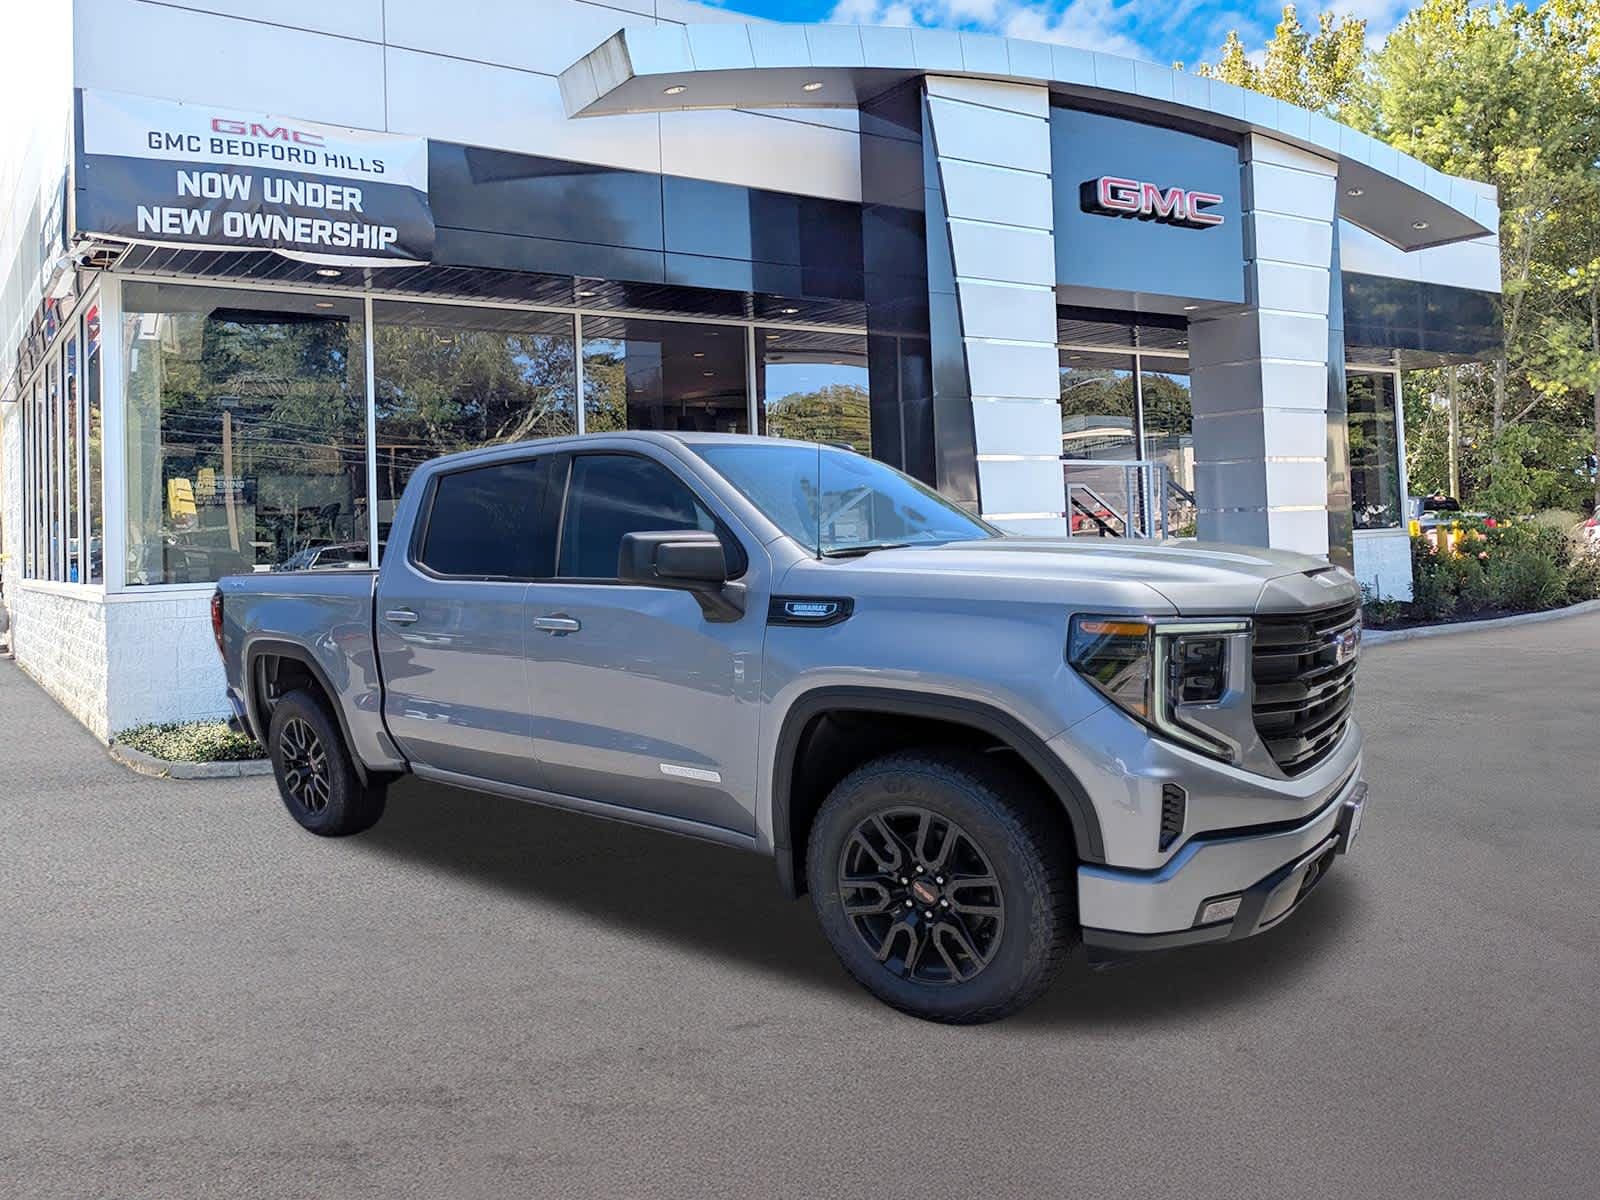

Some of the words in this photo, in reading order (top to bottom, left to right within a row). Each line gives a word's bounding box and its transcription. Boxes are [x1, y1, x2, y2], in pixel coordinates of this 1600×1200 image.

[147, 131, 201, 153] GMC
[210, 138, 317, 165] BEDFORD
[324, 153, 385, 174] HILLS
[211, 117, 326, 148] GMC
[177, 170, 252, 201] NOW
[264, 177, 364, 213] UNDER
[1096, 175, 1225, 225] GMC
[136, 205, 212, 236] NEW
[223, 211, 398, 250] OWNERSHIP
